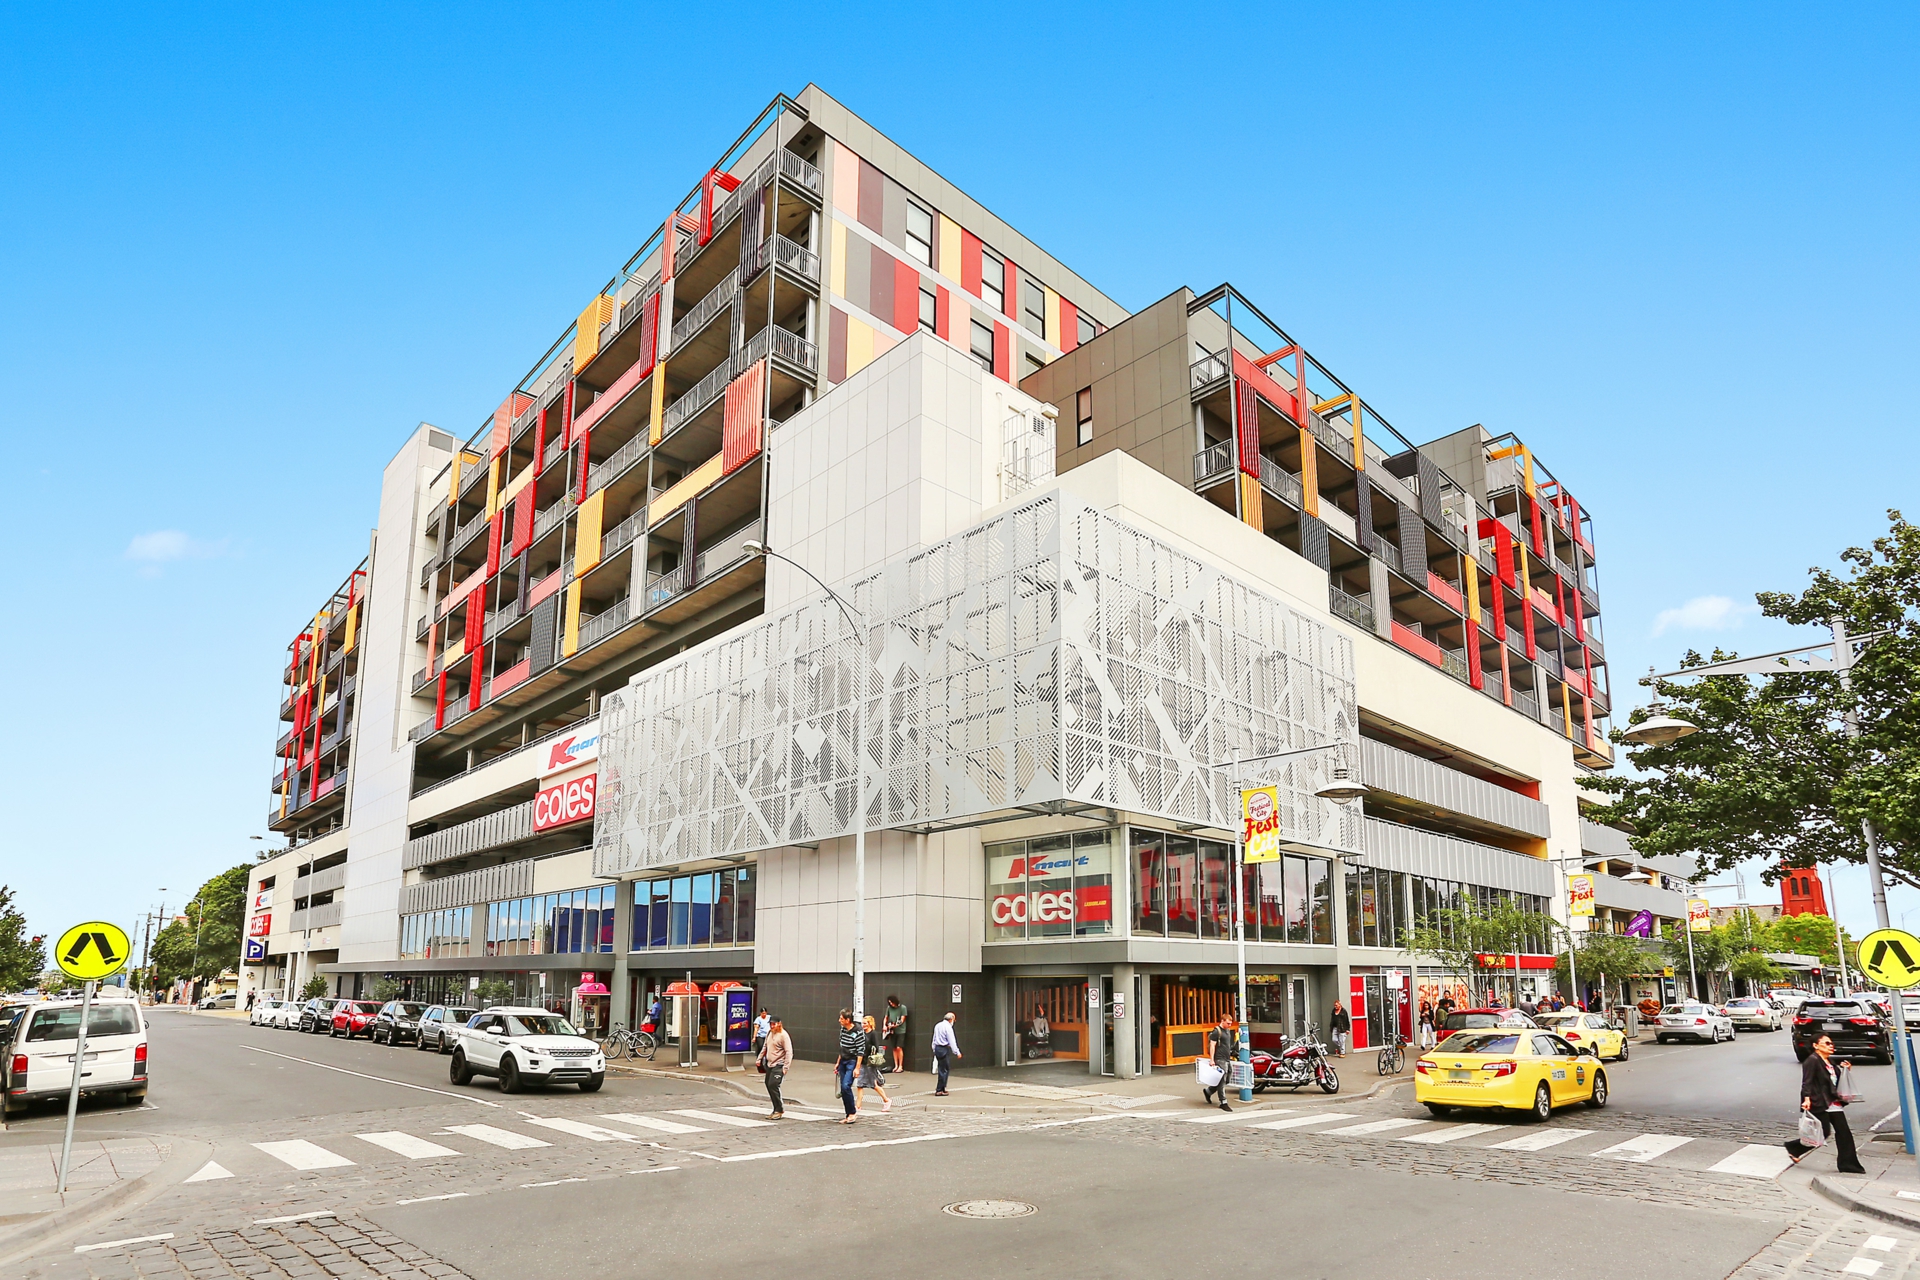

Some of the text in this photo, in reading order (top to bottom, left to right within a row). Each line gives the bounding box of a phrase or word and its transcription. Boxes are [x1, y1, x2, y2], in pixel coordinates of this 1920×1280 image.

[535, 777, 595, 828] coles
[1244, 810, 1280, 843] Fest
[1008, 854, 1090, 879] Kmart
[991, 891, 1079, 924] coles
[1570, 887, 1594, 905] Fest
[1689, 909, 1710, 922] Fest
[249, 945, 261, 957] P
